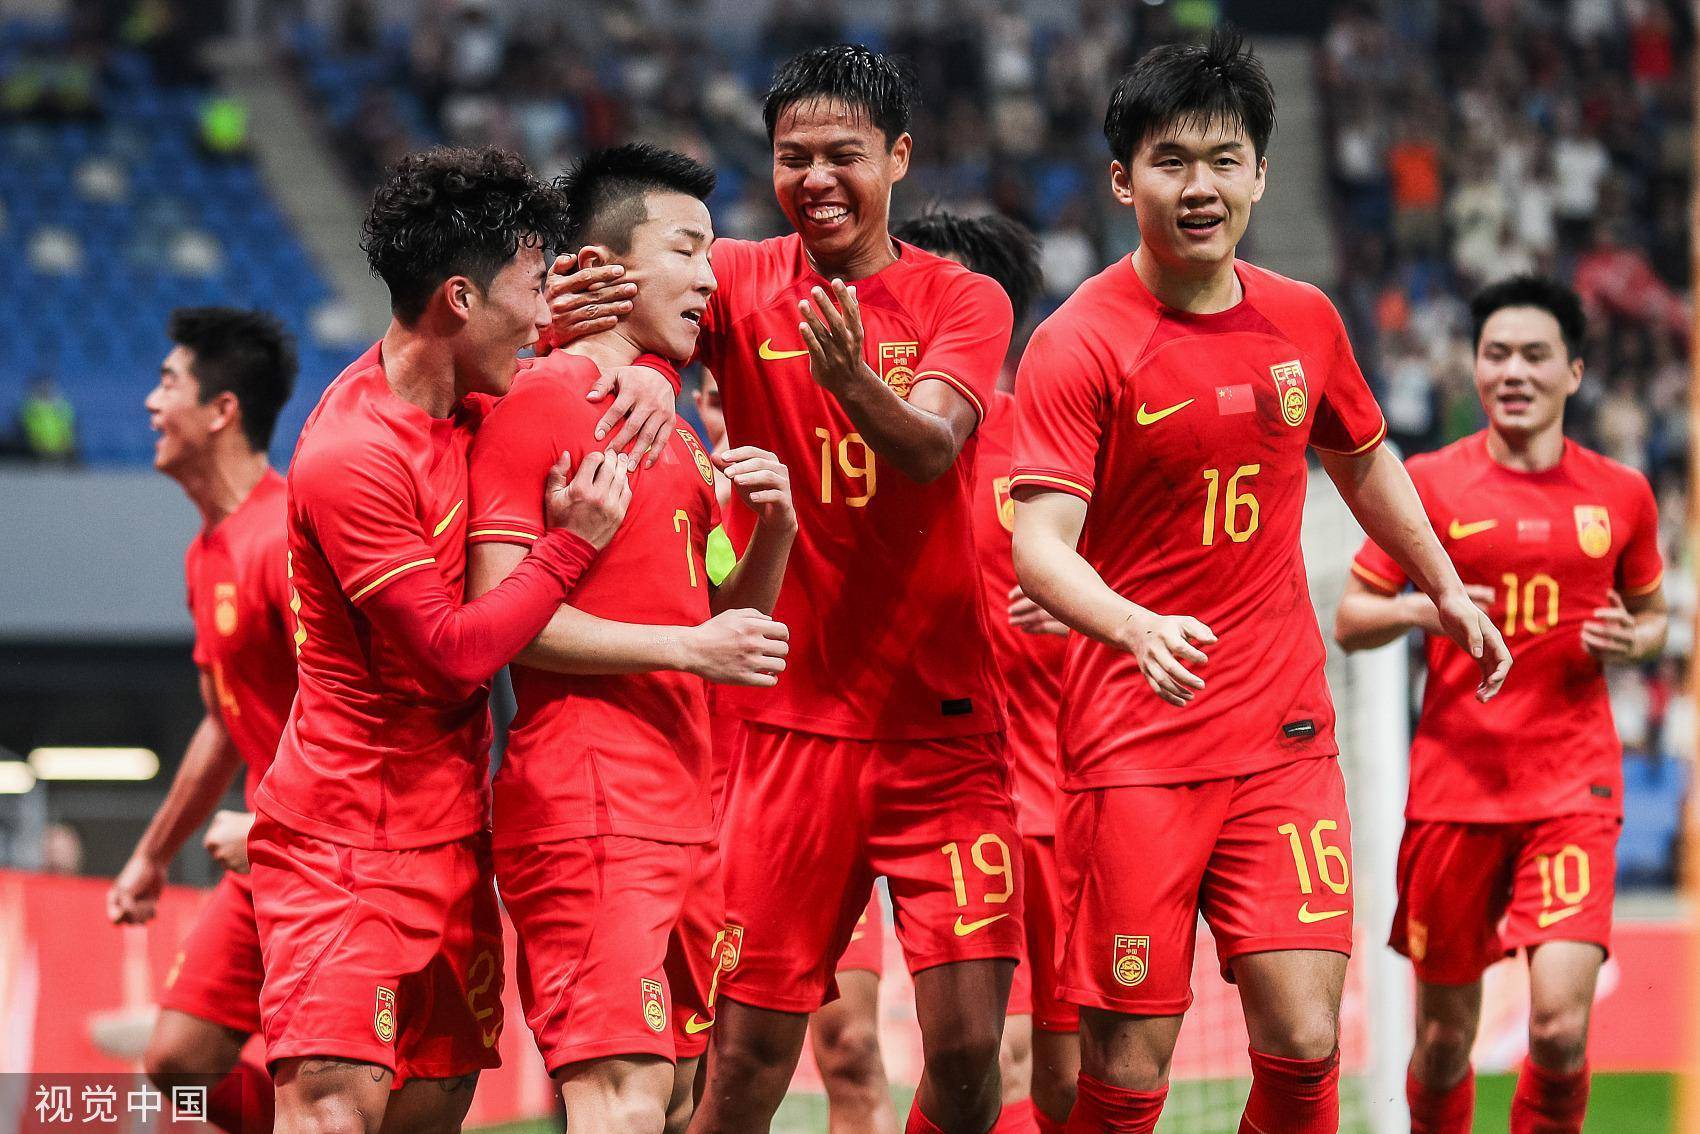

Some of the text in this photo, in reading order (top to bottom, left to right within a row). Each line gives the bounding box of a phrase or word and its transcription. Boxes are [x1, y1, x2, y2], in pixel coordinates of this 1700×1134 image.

[882, 346, 917, 358] CFA
[1274, 366, 1303, 381] CFA
[815, 426, 877, 508] 19
[1202, 463, 1261, 546] 16
[672, 509, 697, 588] 7
[1502, 572, 1559, 637] 10
[941, 833, 1014, 907] 19
[1278, 819, 1350, 895] 16
[1536, 844, 1590, 906] 10
[1117, 938, 1147, 949] CFA
